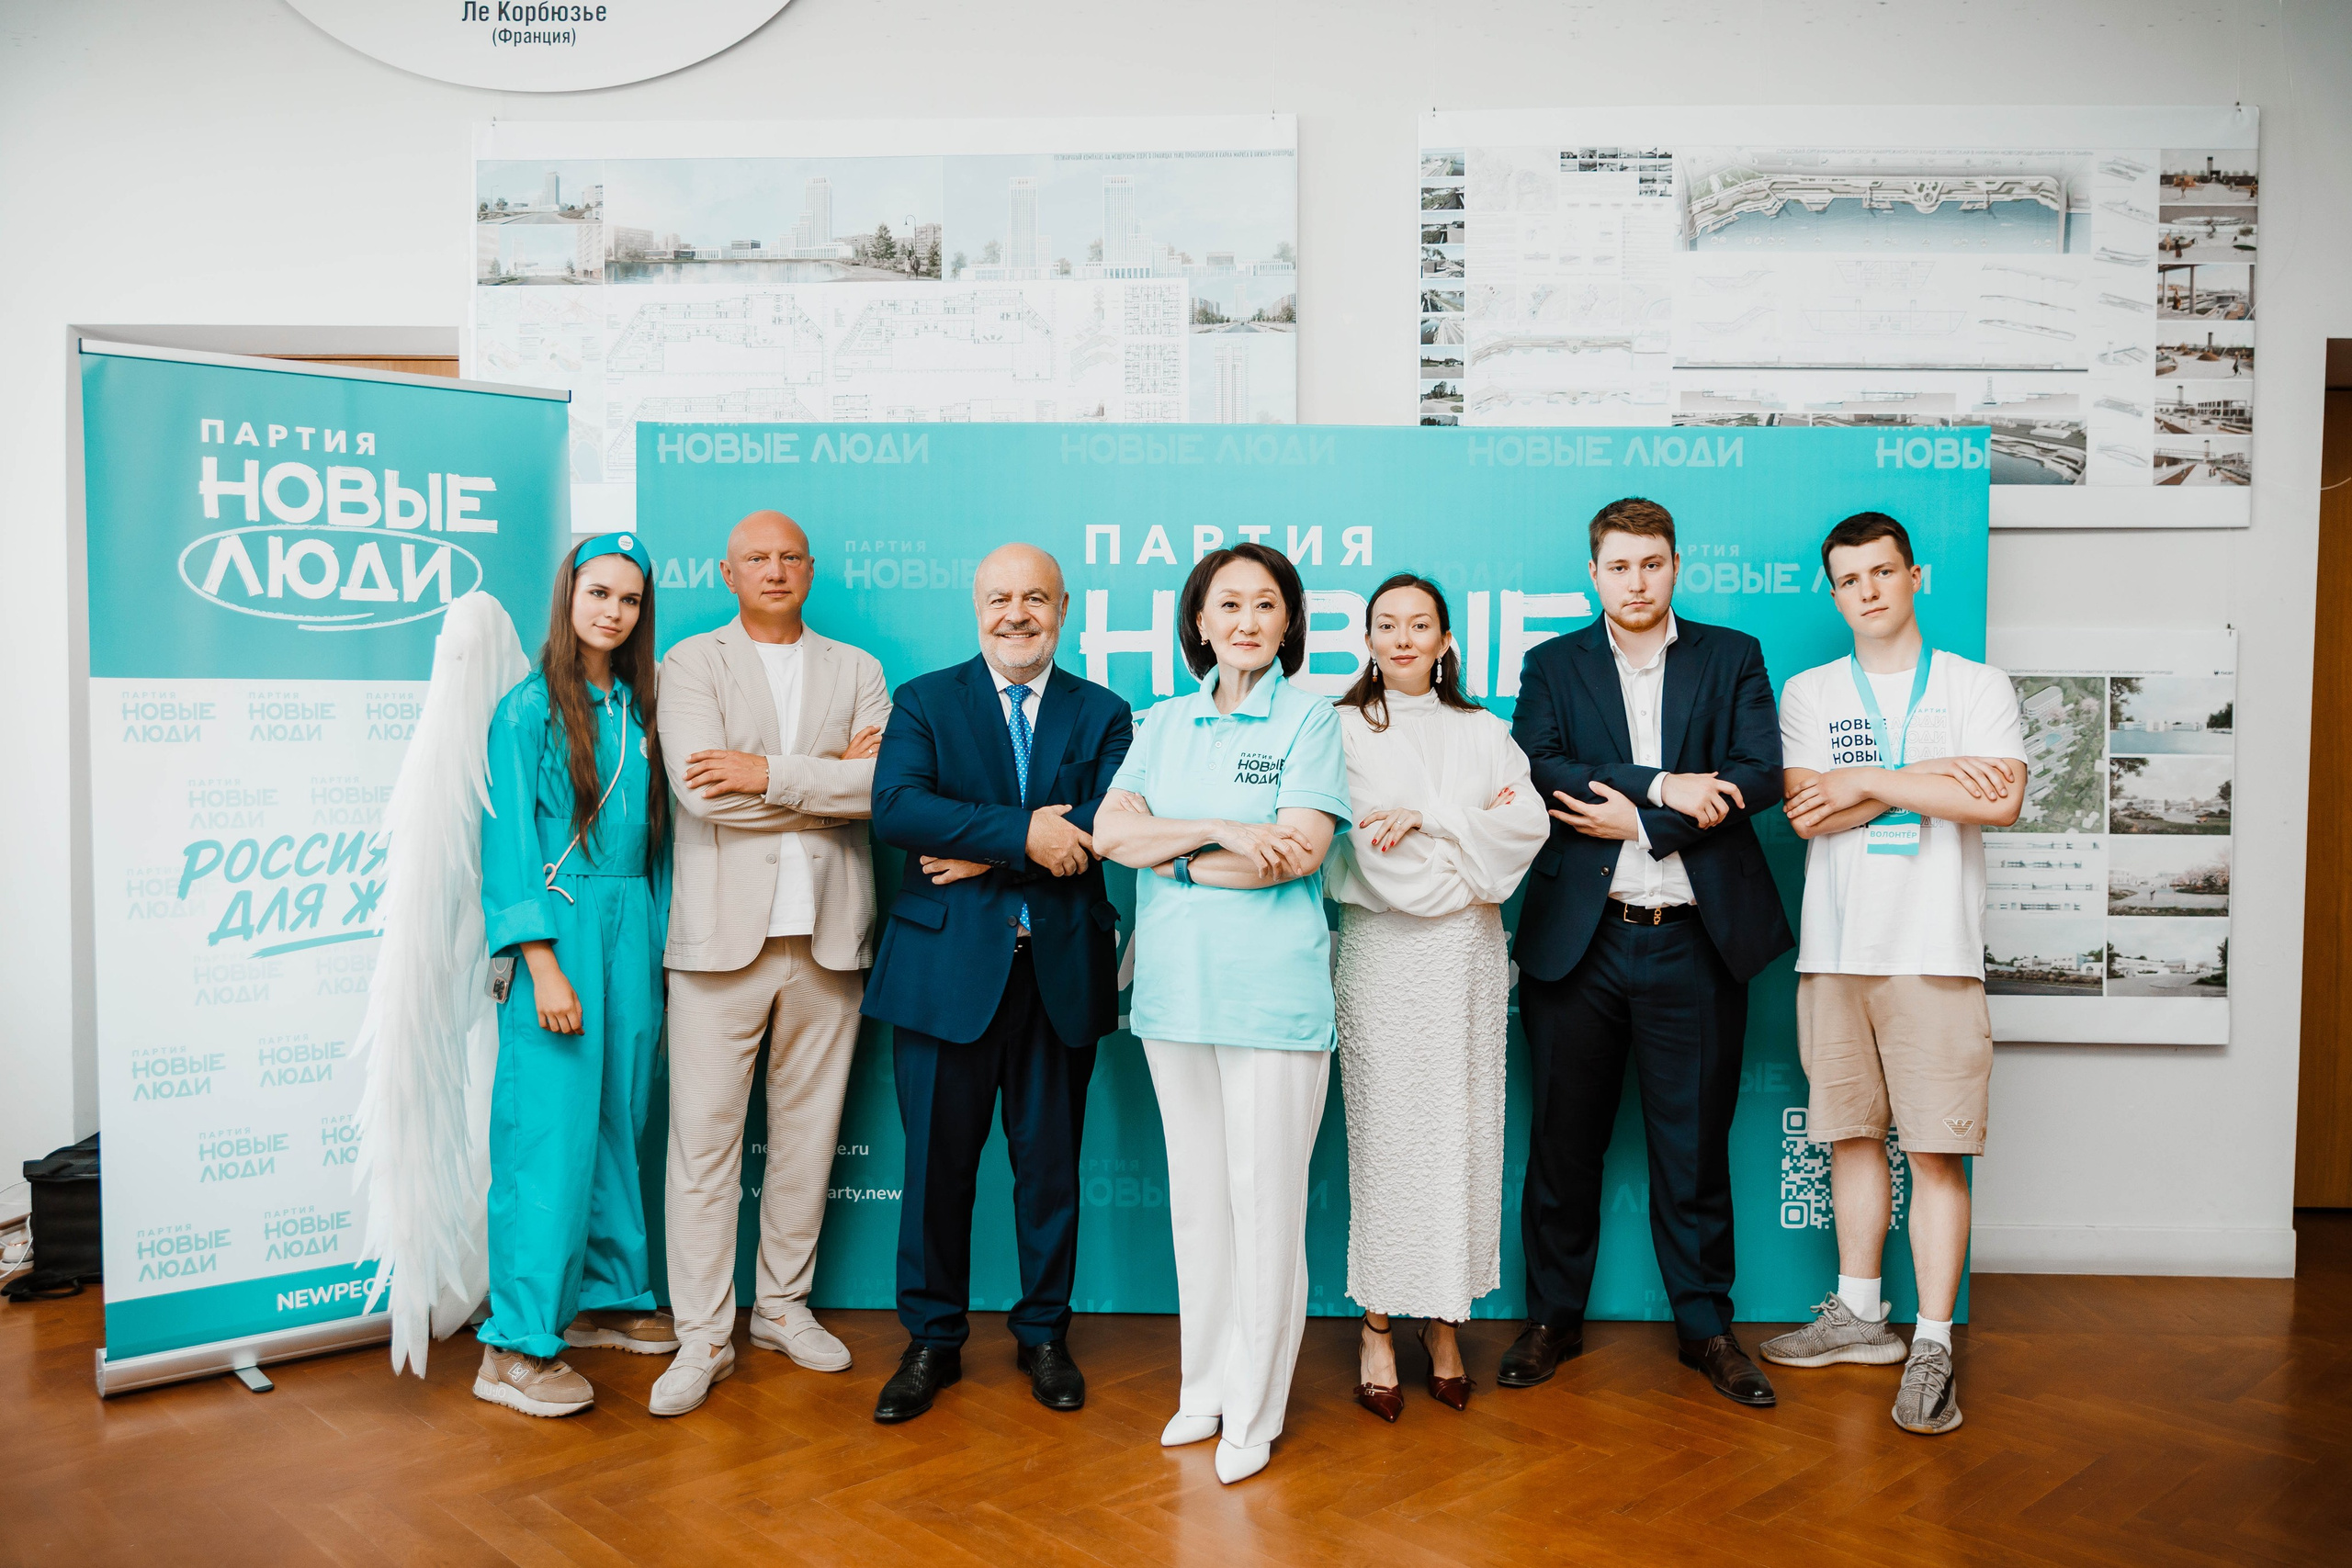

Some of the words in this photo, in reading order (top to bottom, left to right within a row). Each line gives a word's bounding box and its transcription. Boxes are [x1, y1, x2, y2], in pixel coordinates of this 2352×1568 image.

[461, 0, 490, 23] Ле
[497, 1, 607, 26] Корбюзье
[492, 27, 577, 47] (Франция)
[200, 418, 377, 456] ПАРТИЯ
[657, 433, 799, 464] НОВЫЕ
[810, 433, 930, 464] ЛЮДИ
[1060, 433, 1204, 465] НОВЫЕ
[1214, 434, 1337, 466] ЛЮДИ
[1466, 435, 1613, 467] НОВЫЕ
[1623, 436, 1745, 468] ЛЮДИ
[1875, 437, 1991, 469] НОВЫ
[198, 456, 499, 533] НОВЫЕ
[844, 540, 927, 552] ПАРТИЯ
[1085, 525, 1374, 566] ПАРТИЯ
[1676, 545, 1740, 558] АРТИЯ
[201, 535, 454, 604] ЛЮДИ
[654, 558, 715, 589] ДИ
[122, 691, 176, 700] ПАРТИЯ
[249, 692, 300, 700] ПАРТИЯ
[121, 702, 217, 721] НОВЫЕ
[248, 702, 336, 721] НОВЫЕ
[366, 703, 424, 720] НОВ
[122, 725, 201, 743] ЛЮДИ
[249, 724, 322, 742] ЛЮДИ
[367, 723, 415, 740] ЛЮД
[1238, 759, 1286, 773] НОВЫЕ
[1240, 752, 1272, 761] ПАРТИЯ
[1234, 773, 1280, 785] ЛЮДИ
[187, 788, 279, 807] НОВЫЕ
[189, 811, 265, 829] ЛЮДИ
[1870, 829, 1917, 839] ВОЛОНТЁР
[177, 829, 393, 901] РОССИЯ
[208, 883, 328, 947] ДЛЯ
[193, 960, 285, 985] НОВЫЕ
[194, 984, 270, 1006] ЛЮДИ
[317, 976, 369, 996] ЛЮД
[258, 1033, 310, 1045] ПАРТИЯ
[131, 1045, 187, 1057] ПАРТИЯ
[258, 1041, 346, 1066] НОВЫЕ
[131, 1052, 227, 1079] НОВЫЕ
[259, 1064, 333, 1088] ЛЮДИ
[132, 1076, 211, 1101] ЛЮДИ
[322, 1114, 353, 1124] ПАРТ
[198, 1126, 251, 1140] ПАРТИЯ
[198, 1133, 289, 1161] НОВЫЕ
[199, 1156, 276, 1183] ЛЮДИ
[264, 1205, 315, 1219] ПАРТИЯ
[138, 1223, 192, 1237] ПАРТИЯ
[264, 1210, 352, 1240] НОВЫЕ
[137, 1228, 232, 1260] НОВЫЕ
[265, 1235, 338, 1262] ЛЮДИ
[138, 1253, 217, 1282] ЛЮДИ
